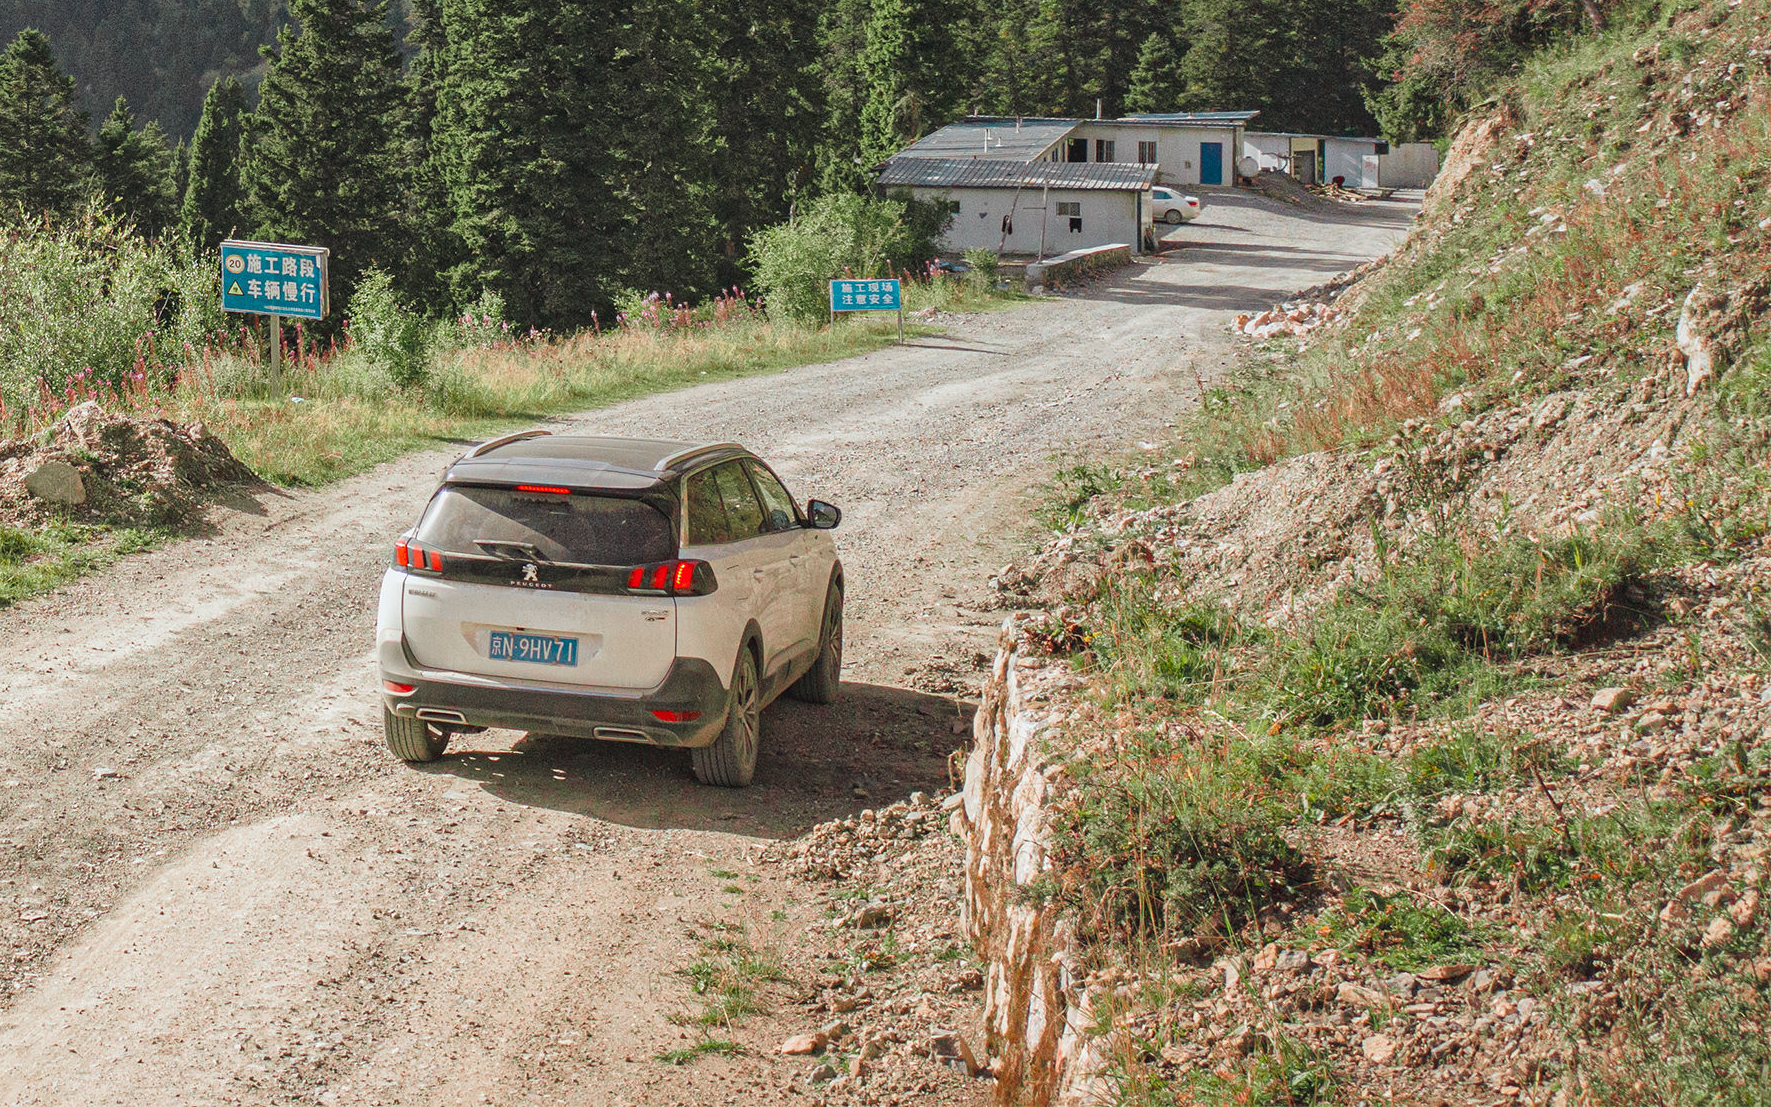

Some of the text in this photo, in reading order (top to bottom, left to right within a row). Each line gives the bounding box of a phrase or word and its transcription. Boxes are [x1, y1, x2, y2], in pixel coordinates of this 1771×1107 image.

[229, 259, 241, 269] 20
[246, 254, 314, 278] 施工路段
[247, 279, 316, 303] 车辆慢行
[841, 282, 893, 293] 施工现场
[842, 294, 894, 305] 注意安全
[510, 580, 553, 589] PEUGEOT
